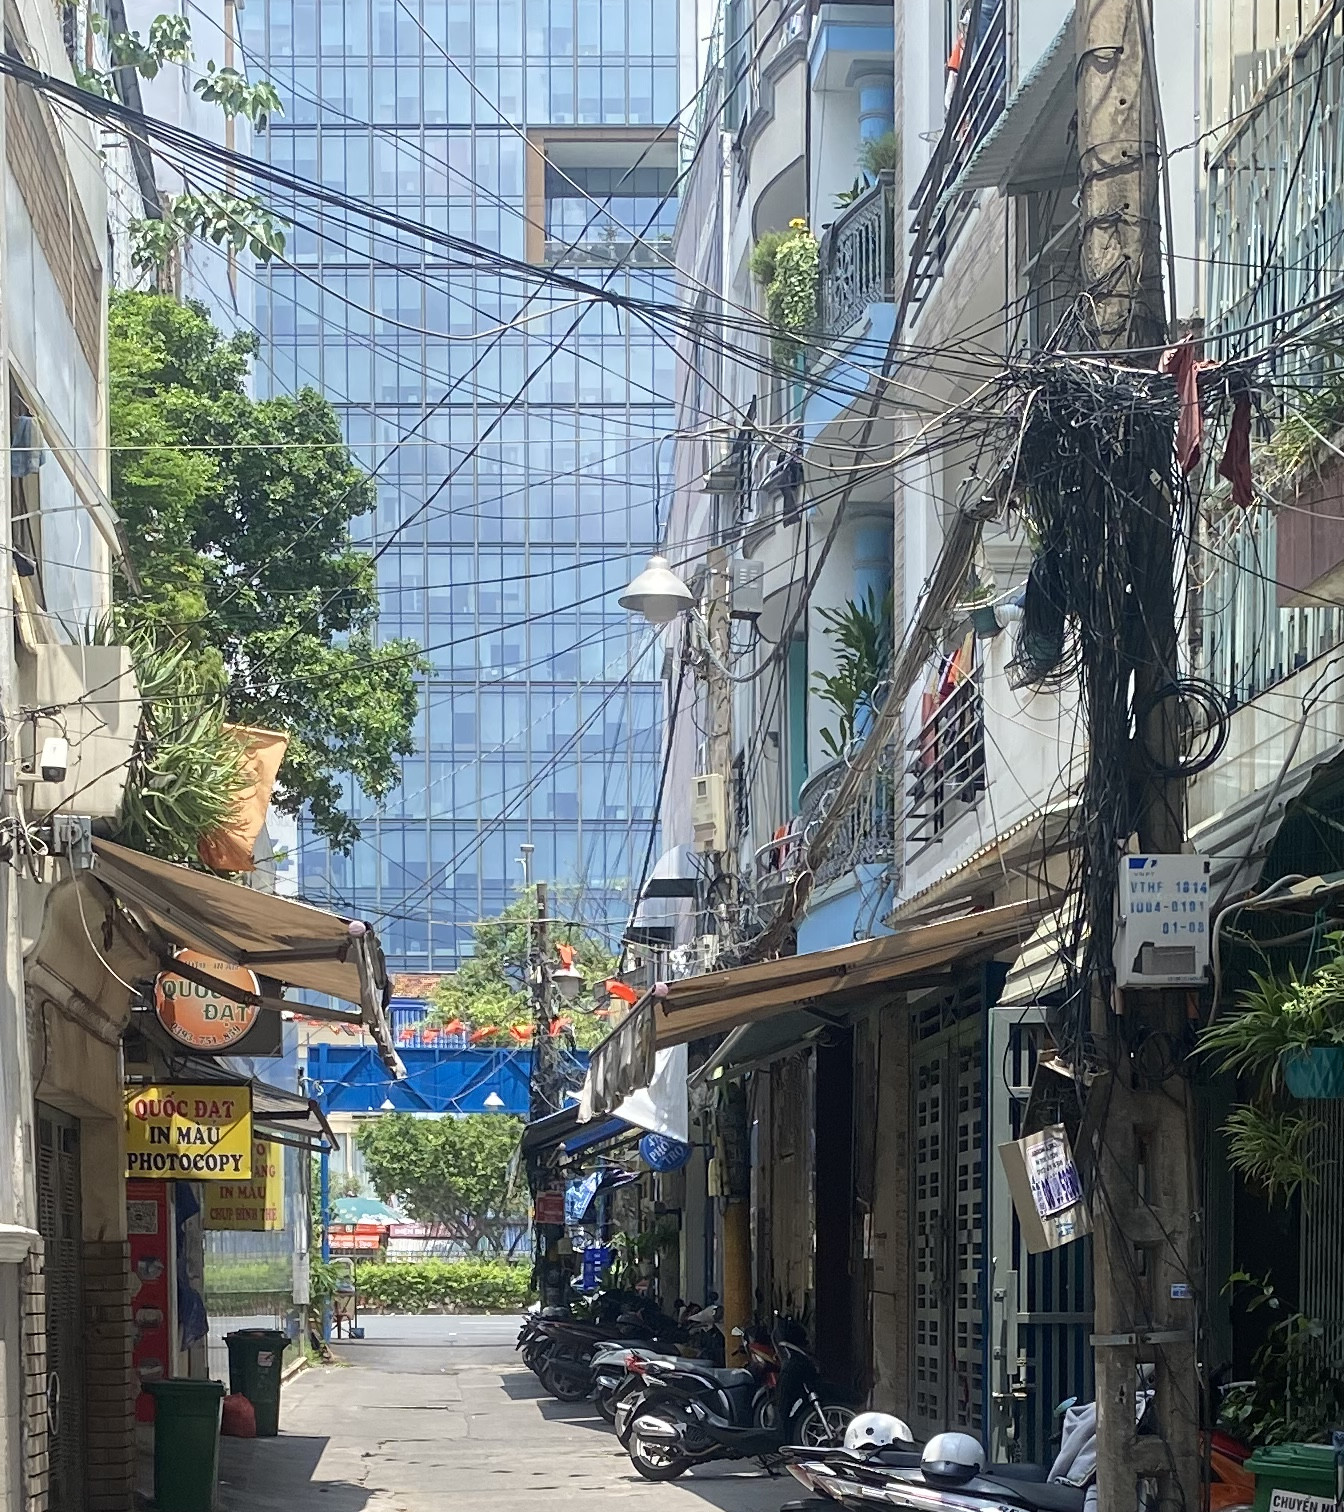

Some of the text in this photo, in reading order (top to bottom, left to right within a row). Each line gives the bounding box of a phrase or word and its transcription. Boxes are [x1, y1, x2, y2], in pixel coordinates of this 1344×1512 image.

[203, 1003, 248, 1027] ĐẠT
[135, 1091, 235, 1123] QUỐC ĐẠT
[149, 1121, 221, 1146] IN MÀU
[127, 1152, 244, 1172] PHOTOCOPY
[219, 1186, 234, 1198] IN
